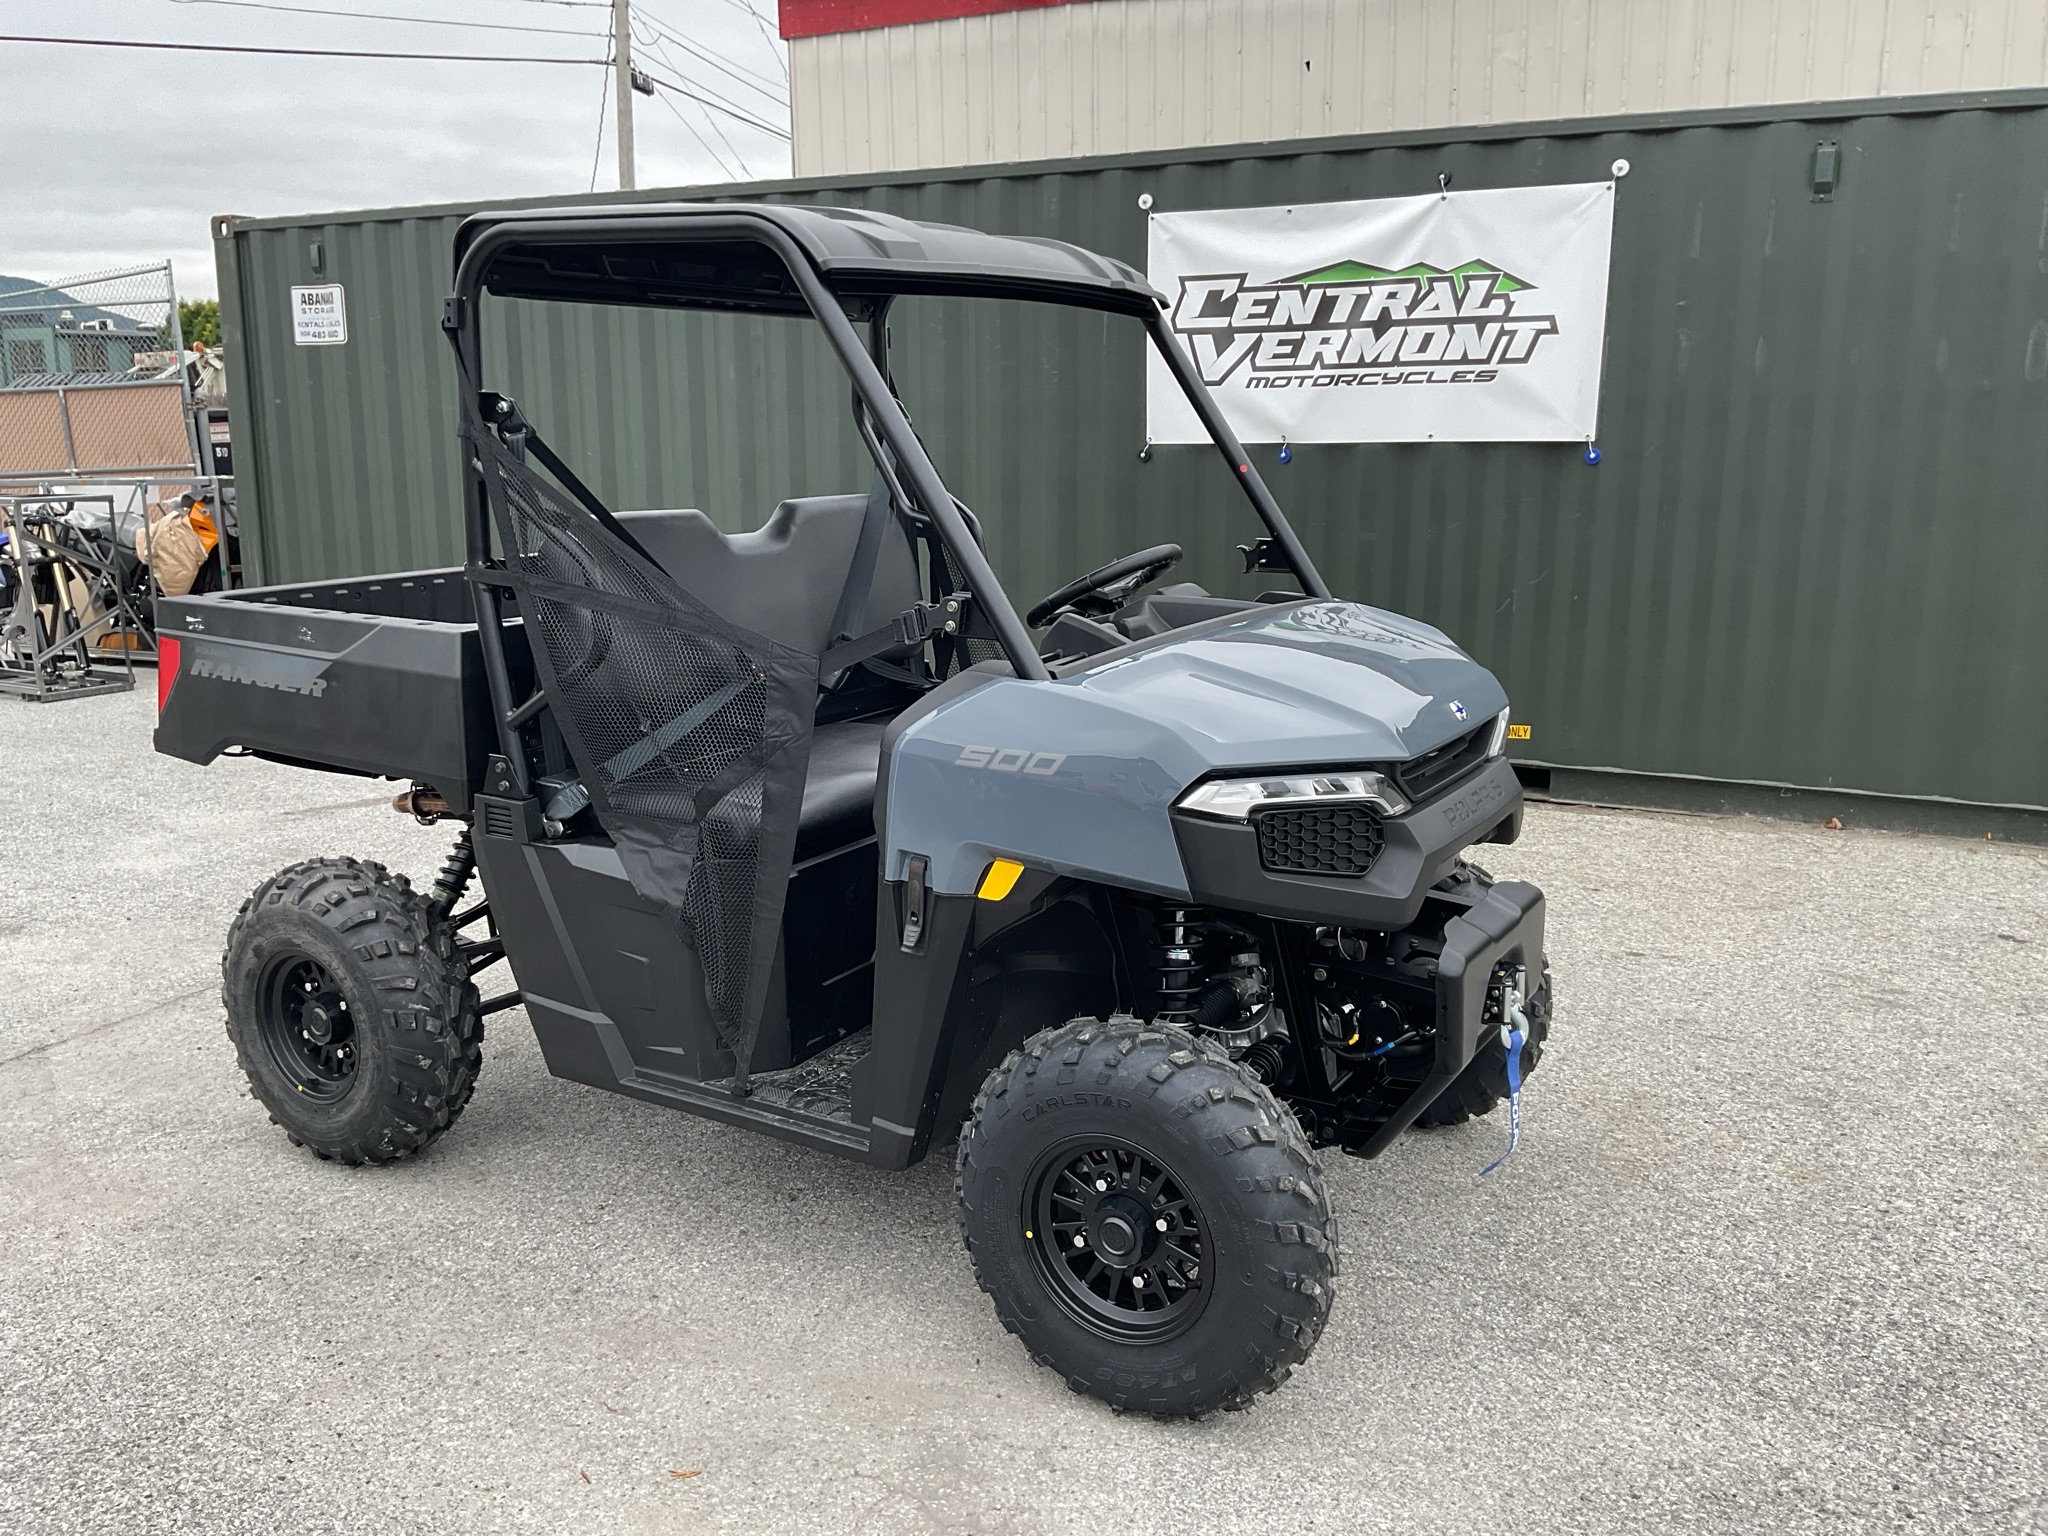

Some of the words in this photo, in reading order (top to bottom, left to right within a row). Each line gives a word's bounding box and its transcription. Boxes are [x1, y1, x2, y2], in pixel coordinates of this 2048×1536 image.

[1174, 273, 1510, 330] CENTRAL
[1191, 317, 1557, 385] VERMONT
[1245, 369, 1499, 389] MOTORCYCLES
[190, 659, 328, 697] RANGER
[955, 744, 1067, 776] 500
[1442, 778, 1505, 829] POLARS
[1021, 1091, 1132, 1122] CARLSTAR
